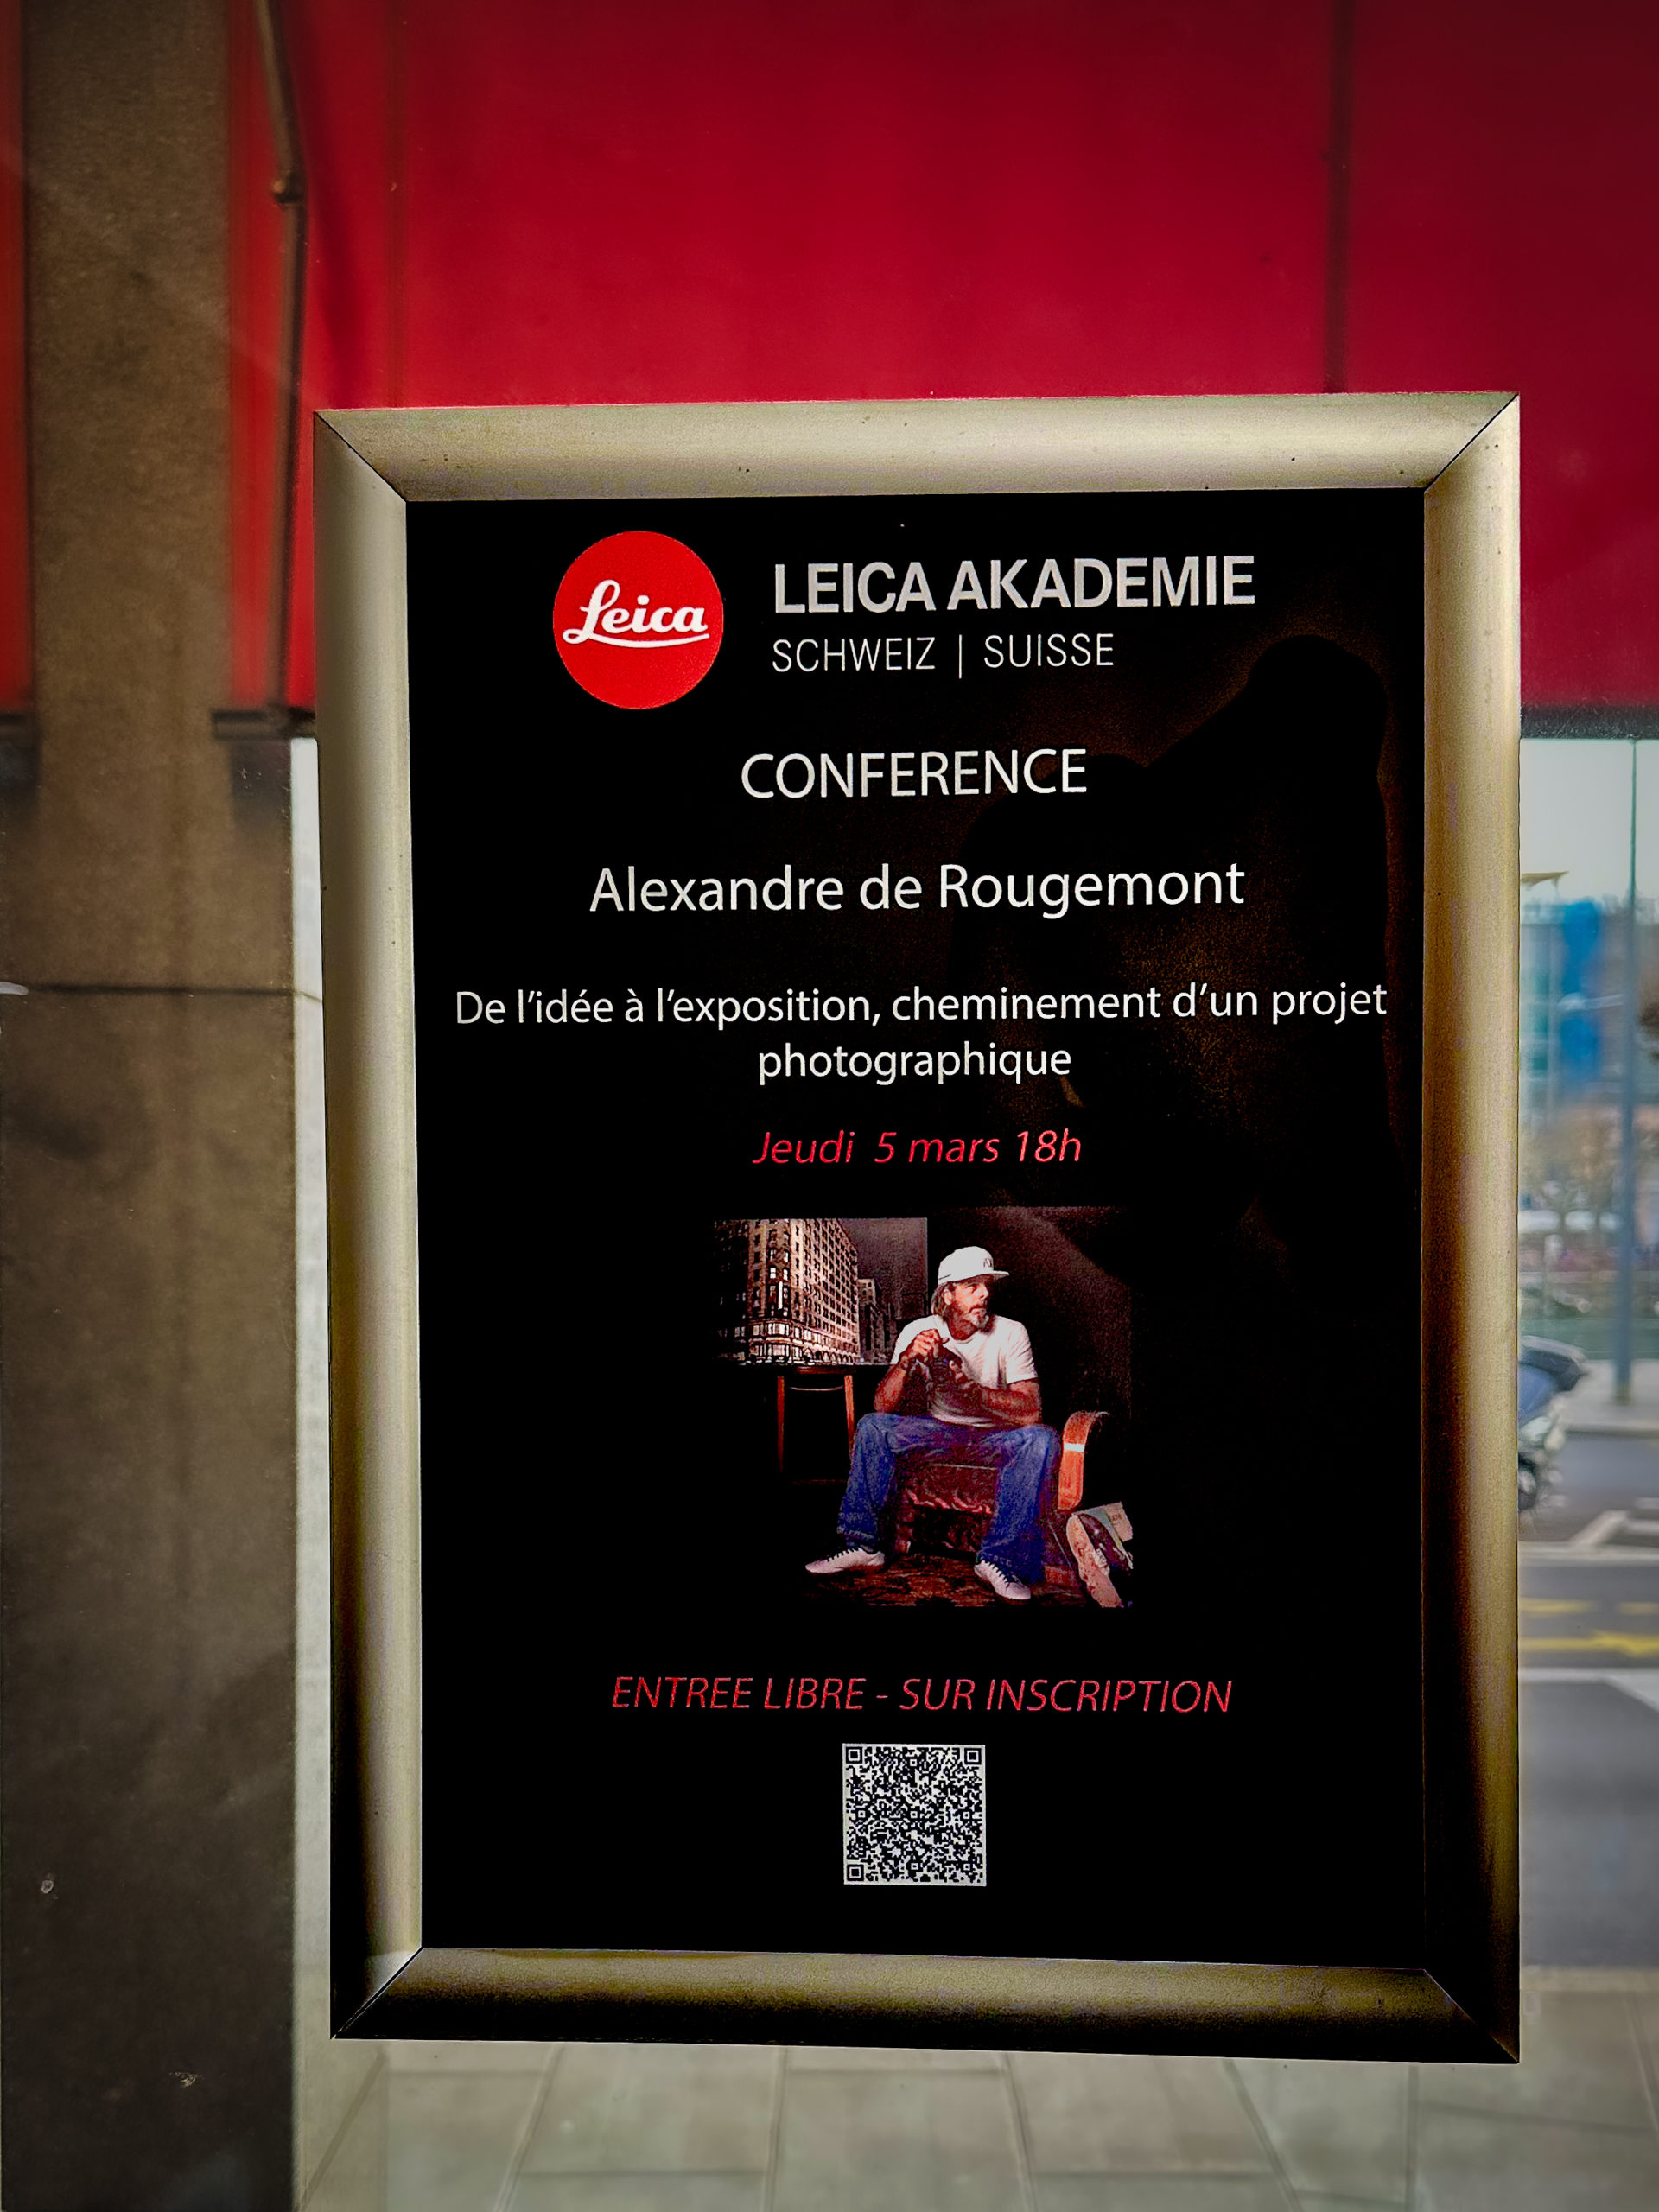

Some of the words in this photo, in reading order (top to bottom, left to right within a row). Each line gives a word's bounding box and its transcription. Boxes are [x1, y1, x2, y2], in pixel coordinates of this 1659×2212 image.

[775, 563, 937, 614] LEICA
[946, 555, 1256, 612] AKADEMIE
[563, 579, 710, 648] Leica
[772, 636, 936, 673] SCHWEIZ
[983, 633, 1115, 669] SUISSE
[741, 749, 1088, 800] CONFERENCE
[589, 865, 846, 913] Alexandre
[860, 863, 924, 912] de
[940, 864, 1247, 921] Rougemont
[456, 992, 507, 1026] De
[518, 989, 615, 1026] l’idée
[625, 989, 645, 1025] à
[892, 986, 1163, 1023] cheminement
[1173, 982, 1260, 1020] d’un
[1272, 982, 1389, 1027] projet
[759, 1041, 1073, 1088] photographique
[752, 1130, 856, 1166] Jeudi
[874, 1132, 898, 1165] 5
[909, 1139, 1001, 1165] mars
[1017, 1128, 1084, 1164] 18h
[612, 1677, 754, 1710] ENTREE
[764, 1678, 868, 1711] LIBRE
[899, 1679, 977, 1713] SUR
[987, 1680, 1234, 1714] INSCRIPTION
